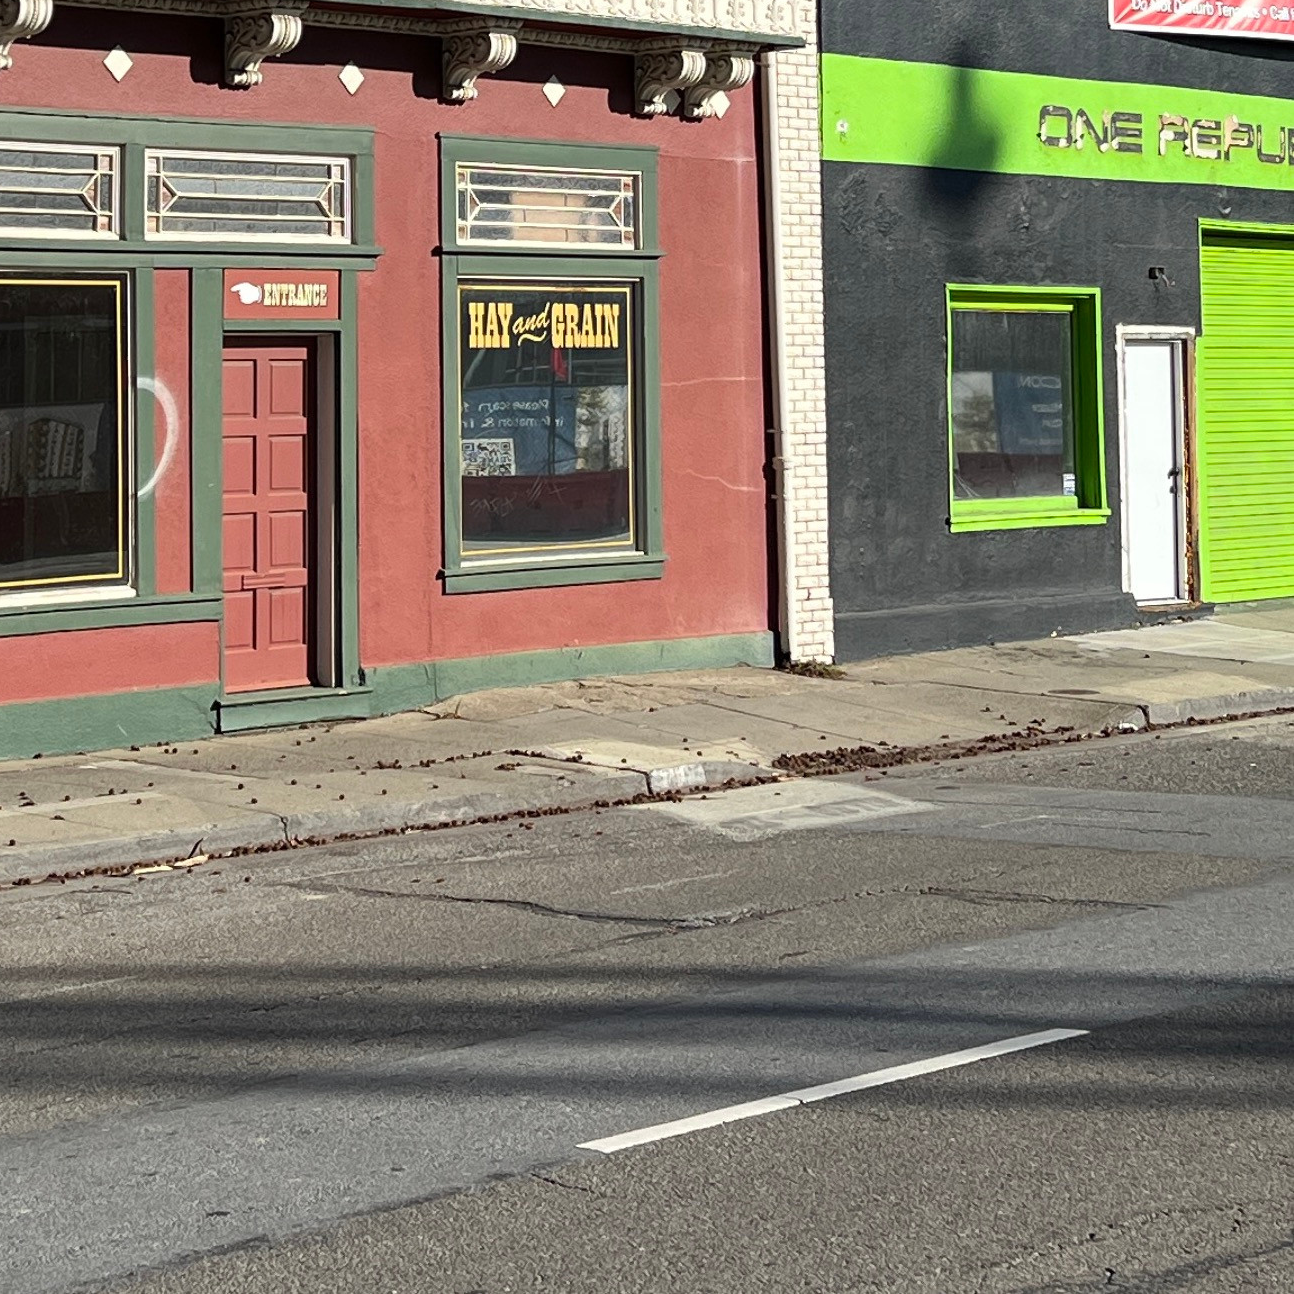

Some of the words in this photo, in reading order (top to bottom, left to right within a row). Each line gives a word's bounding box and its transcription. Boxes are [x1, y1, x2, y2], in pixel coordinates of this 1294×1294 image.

[1038, 105, 1142, 153] ONE
[1157, 113, 1294, 167] REPU
[263, 283, 328, 307] ENTRANCE
[468, 302, 513, 349] HAY
[512, 302, 551, 343] and
[551, 303, 620, 349] GRAIN
